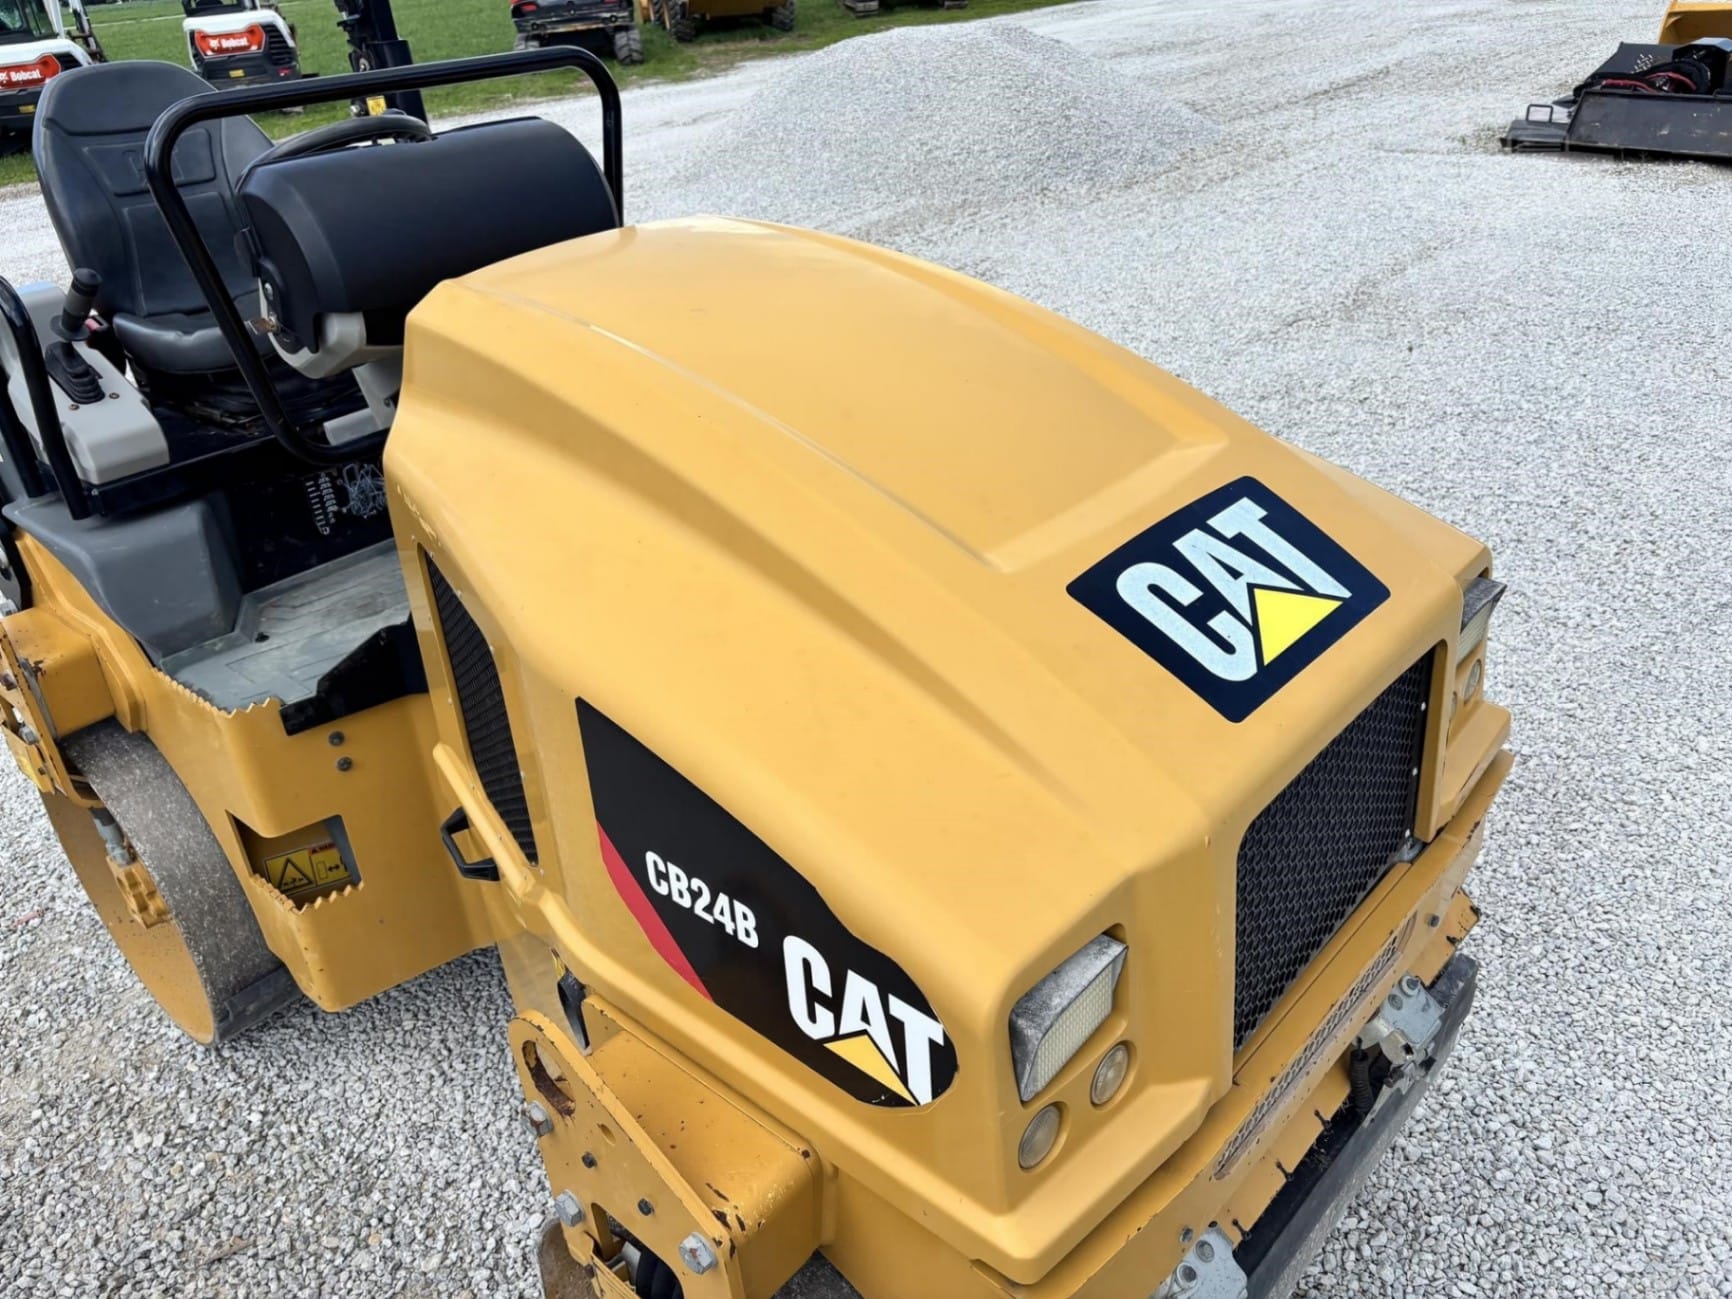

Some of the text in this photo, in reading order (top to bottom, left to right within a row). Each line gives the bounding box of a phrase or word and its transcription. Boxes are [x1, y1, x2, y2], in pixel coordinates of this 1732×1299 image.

[10, 69, 41, 81] Bobcat
[220, 36, 248, 48] Bobcat
[1116, 497, 1352, 681] CAT
[645, 851, 758, 948] CB24B
[783, 935, 944, 1106] CAT
